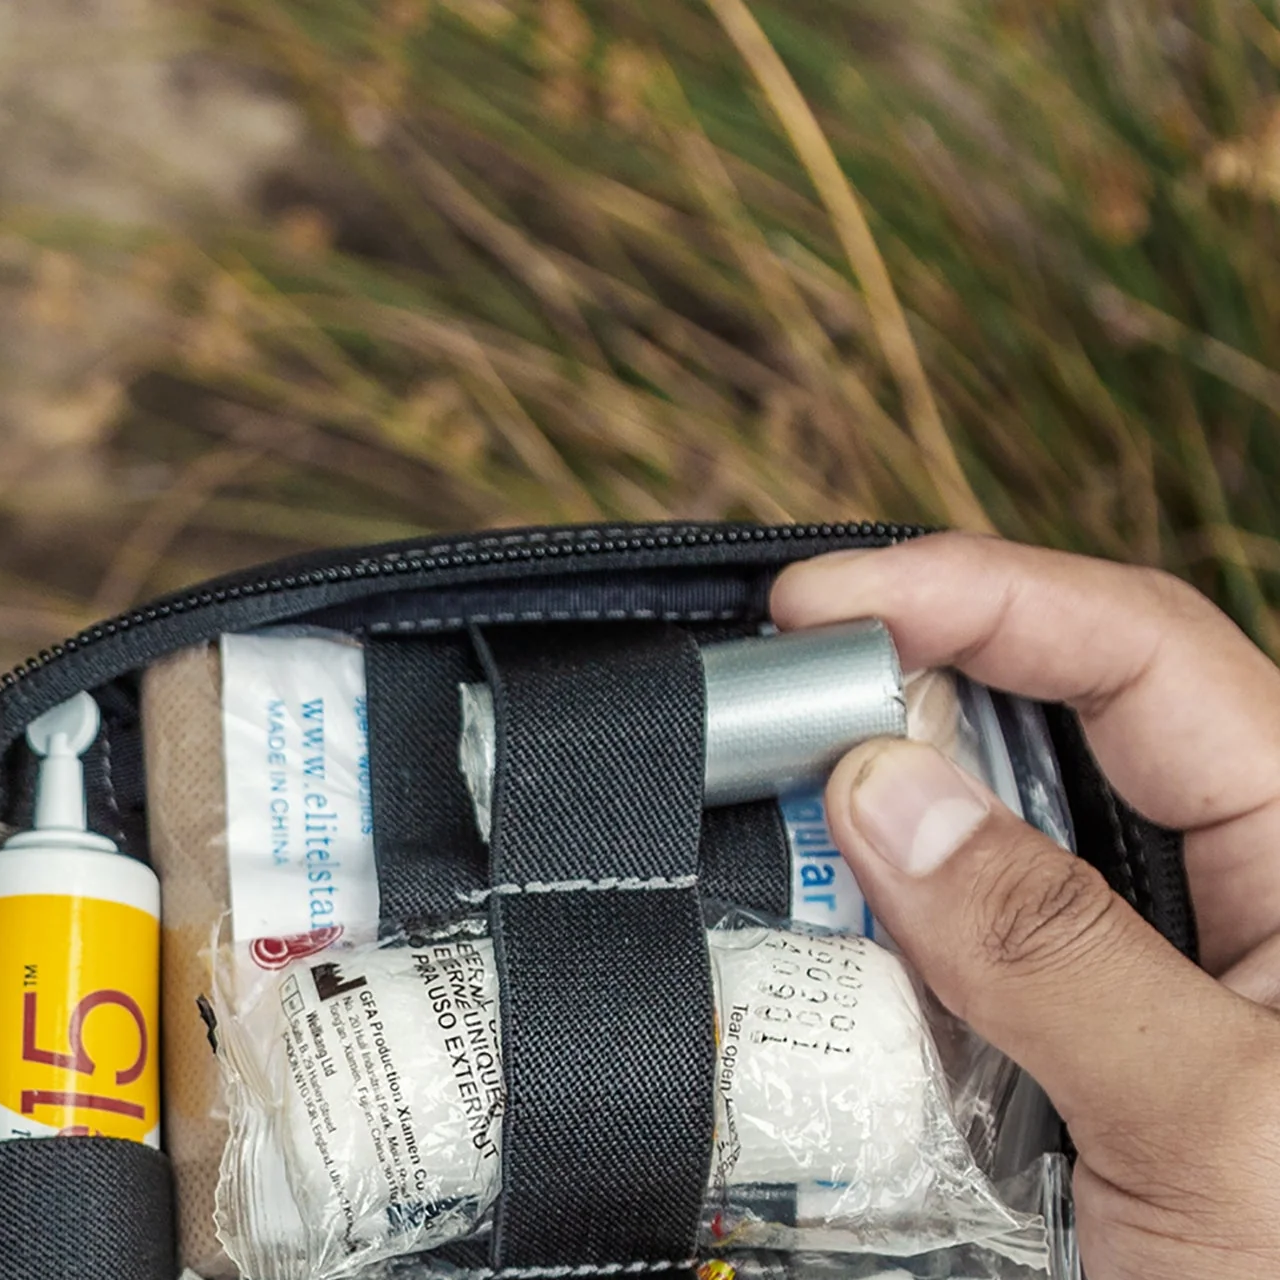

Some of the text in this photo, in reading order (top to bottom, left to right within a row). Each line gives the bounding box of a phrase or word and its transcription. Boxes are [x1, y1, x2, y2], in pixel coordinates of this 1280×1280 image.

[266, 700, 291, 866] MADE IN CHINA
[427, 986, 458, 1030] USO
[726, 1003, 750, 1042] Tear
[320, 1057, 336, 1077] Ltd
[359, 990, 379, 1019] GFA
[370, 1021, 404, 1103] Production
[396, 1104, 421, 1165] Xiamen
[719, 1043, 739, 1092] open
